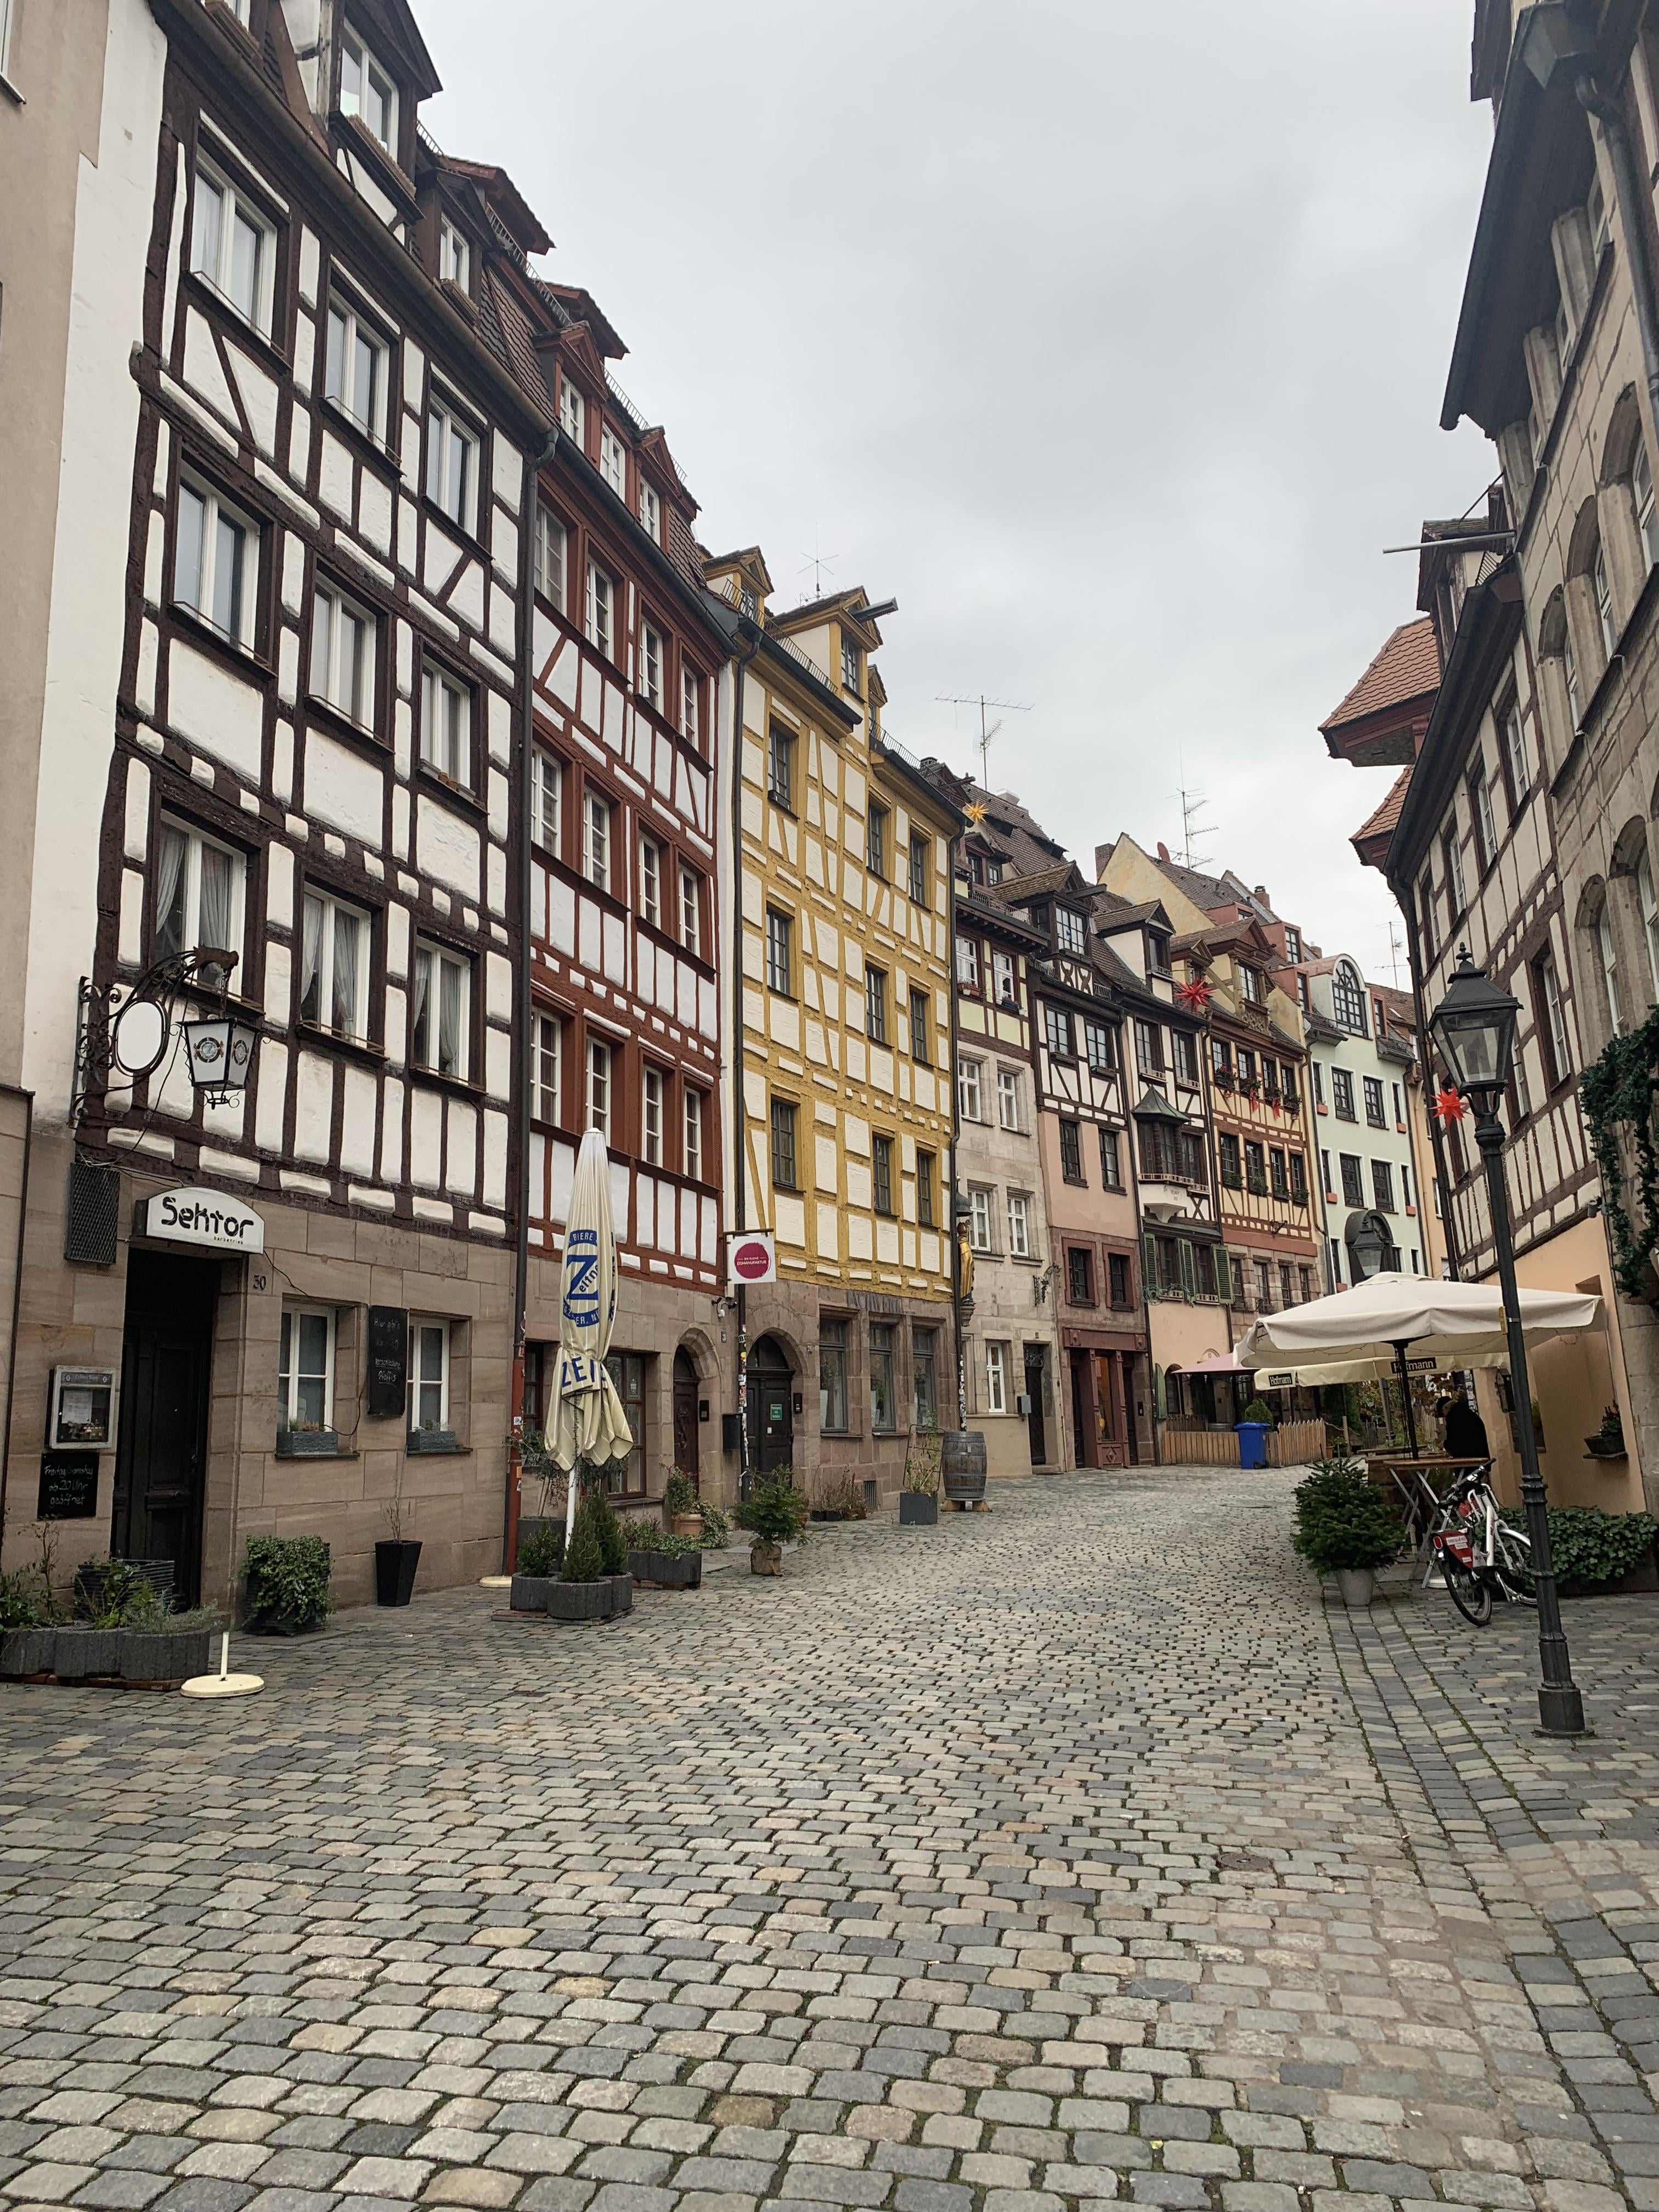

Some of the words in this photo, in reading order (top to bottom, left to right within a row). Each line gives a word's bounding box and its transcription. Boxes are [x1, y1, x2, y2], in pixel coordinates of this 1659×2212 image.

[161, 1197, 254, 1238] Sektor
[573, 1232, 593, 1241] BIERE
[1393, 1361, 1434, 1372] Hfmann
[1270, 1375, 1291, 1386] Hofmann
[59, 1480, 71, 1490] 20
[72, 1480, 88, 1491] Uhr
